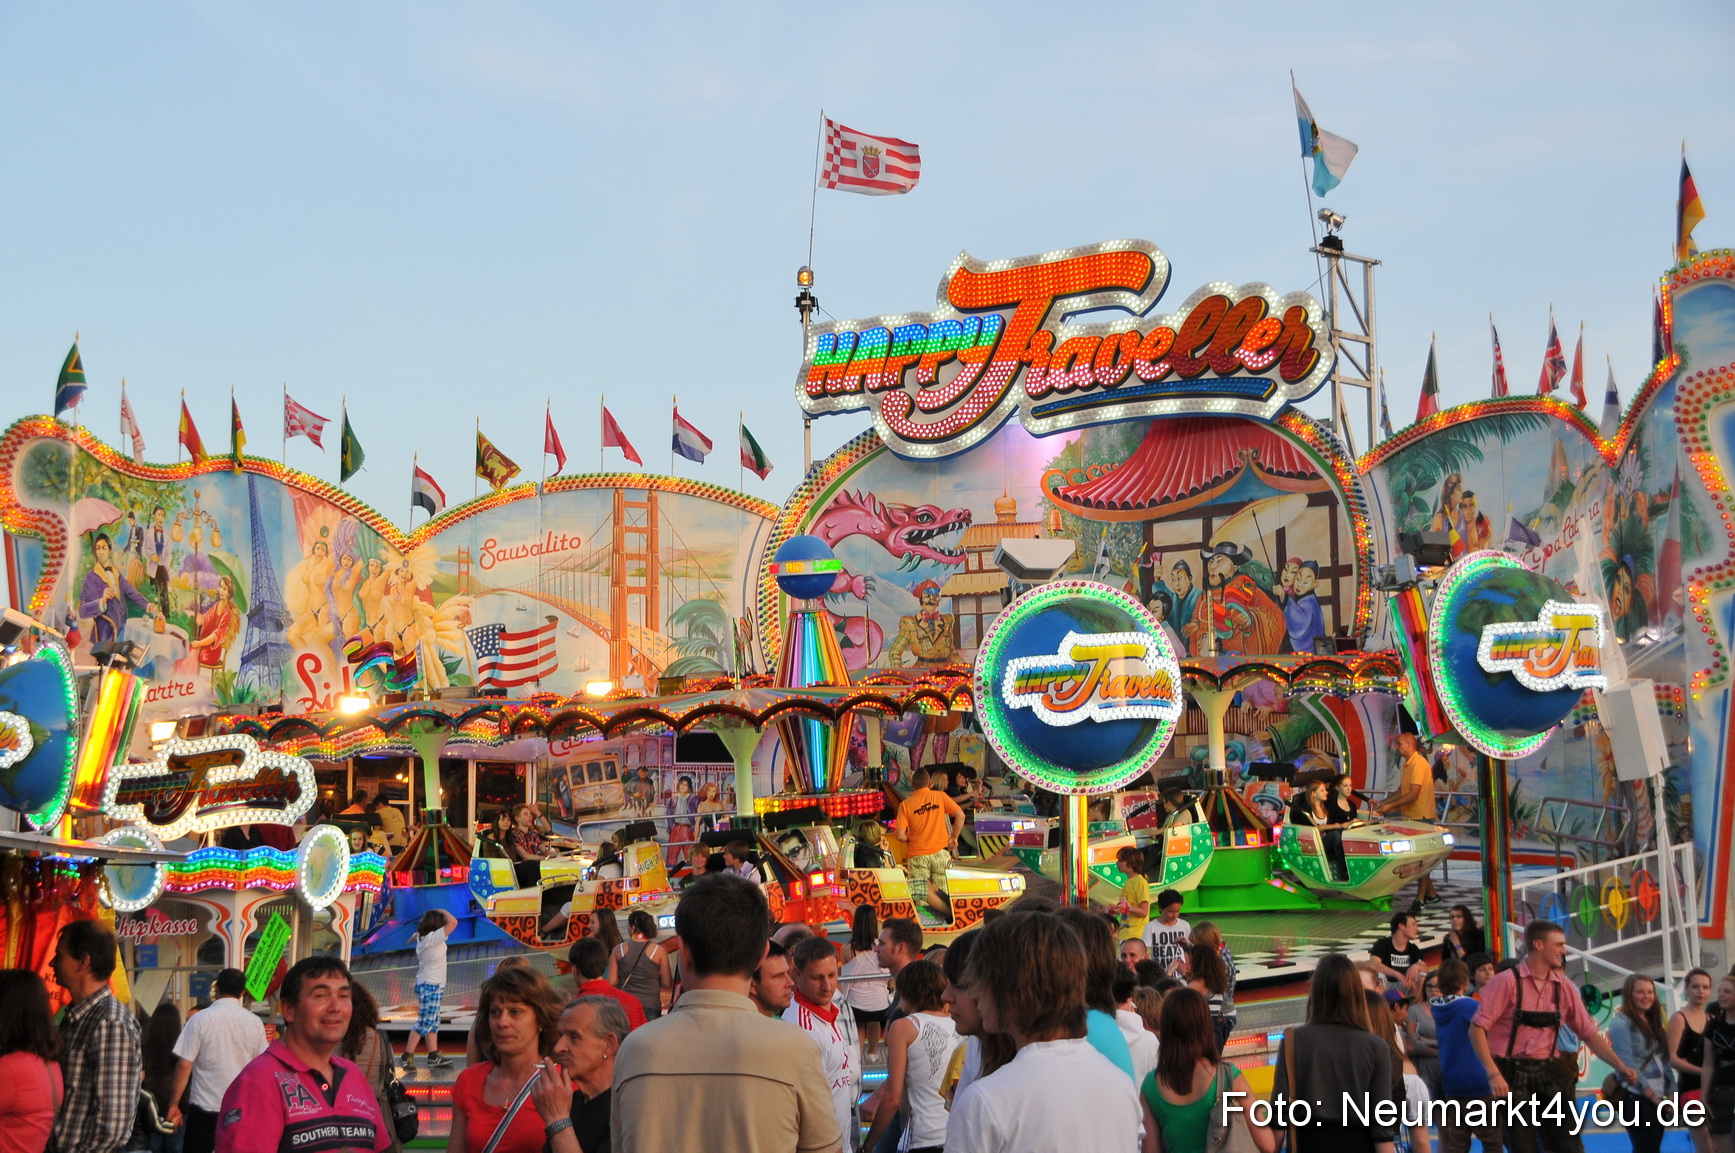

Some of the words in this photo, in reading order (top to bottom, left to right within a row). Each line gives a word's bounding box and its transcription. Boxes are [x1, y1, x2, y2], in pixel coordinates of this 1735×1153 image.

[804, 313, 1004, 411] HAPPY
[881, 250, 1319, 441] Traveller
[479, 531, 582, 570] Sausalito
[785, 562, 805, 573] RIO
[1490, 632, 1566, 666] HAPPY
[144, 680, 196, 704] artre
[296, 652, 366, 712] Lid
[1013, 662, 1091, 701] HAPPY
[341, 1126, 367, 1137] TEAM
